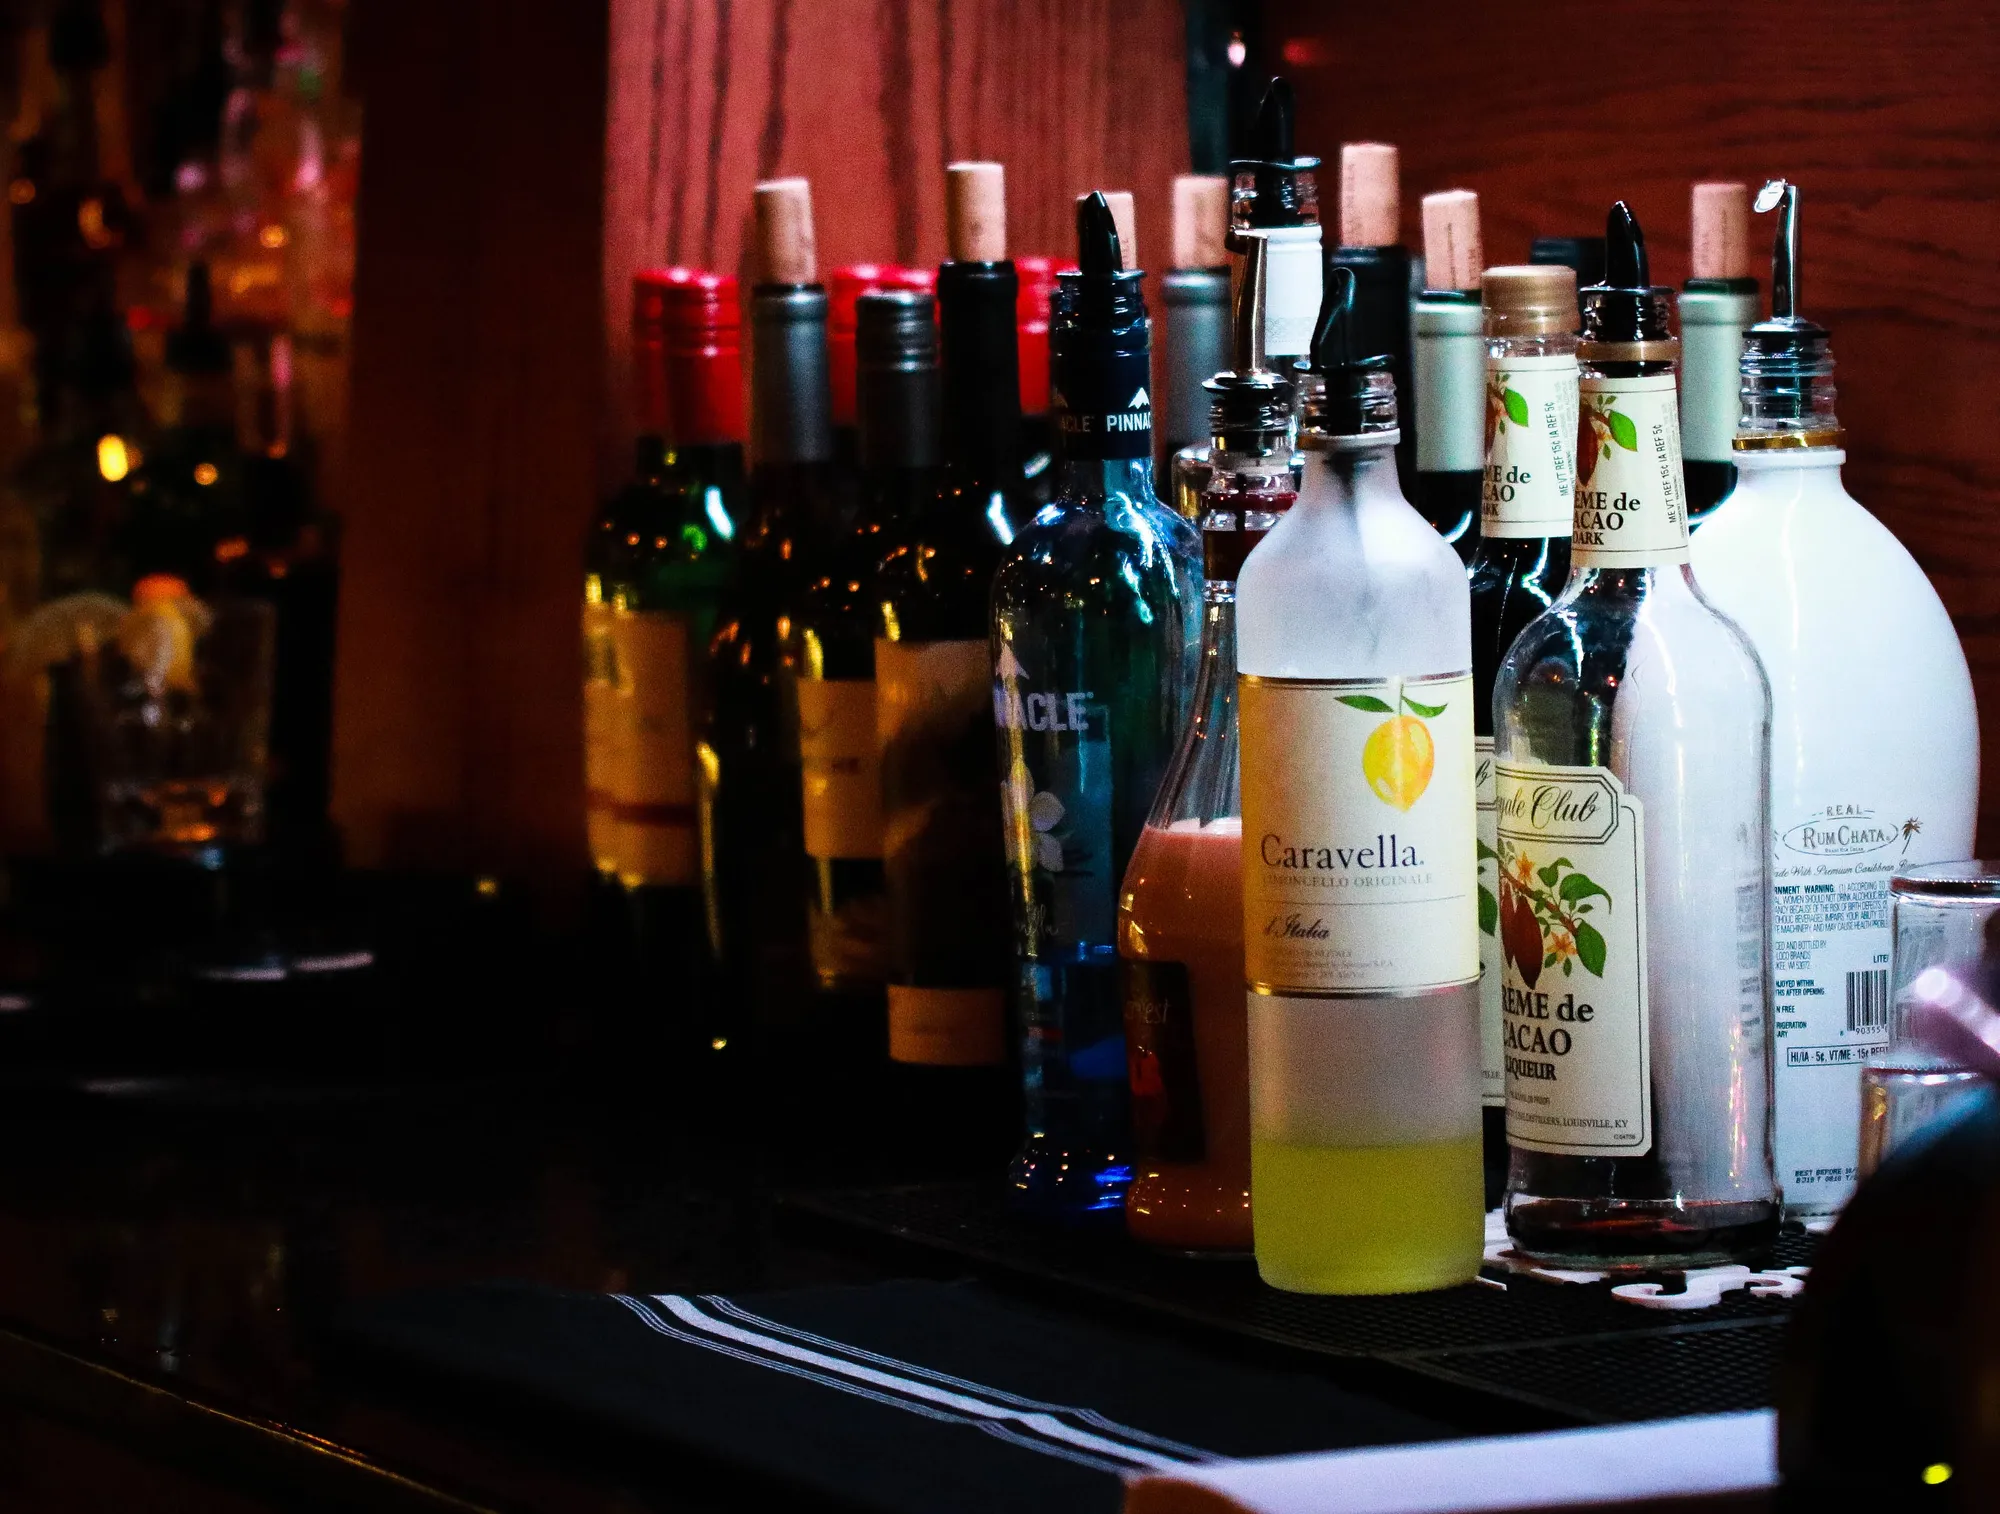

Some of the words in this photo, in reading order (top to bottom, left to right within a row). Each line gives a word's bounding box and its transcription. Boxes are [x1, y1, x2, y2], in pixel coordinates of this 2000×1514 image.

[1546, 413, 1557, 428] REF
[1655, 433, 1666, 452] REF
[1553, 456, 1564, 470] REF
[1506, 465, 1531, 484] de
[1662, 480, 1673, 496] REF
[1613, 492, 1641, 511] de
[1668, 510, 1677, 524] ME
[1531, 785, 1599, 829] Club
[1826, 804, 1863, 817] REAL
[1791, 866, 1812, 877] With
[1813, 864, 1853, 877] Premium
[1855, 862, 1895, 874] Caribbean
[1555, 993, 1595, 1023] de
[1782, 1005, 1796, 1013] FREE
[1790, 1051, 1810, 1064] HI/IA
[1829, 1049, 1851, 1061] VT/ME
[1615, 1119, 1628, 1129] KY
[1795, 1169, 1813, 1177] BEST
[1816, 1168, 1842, 1176] BEFORE
